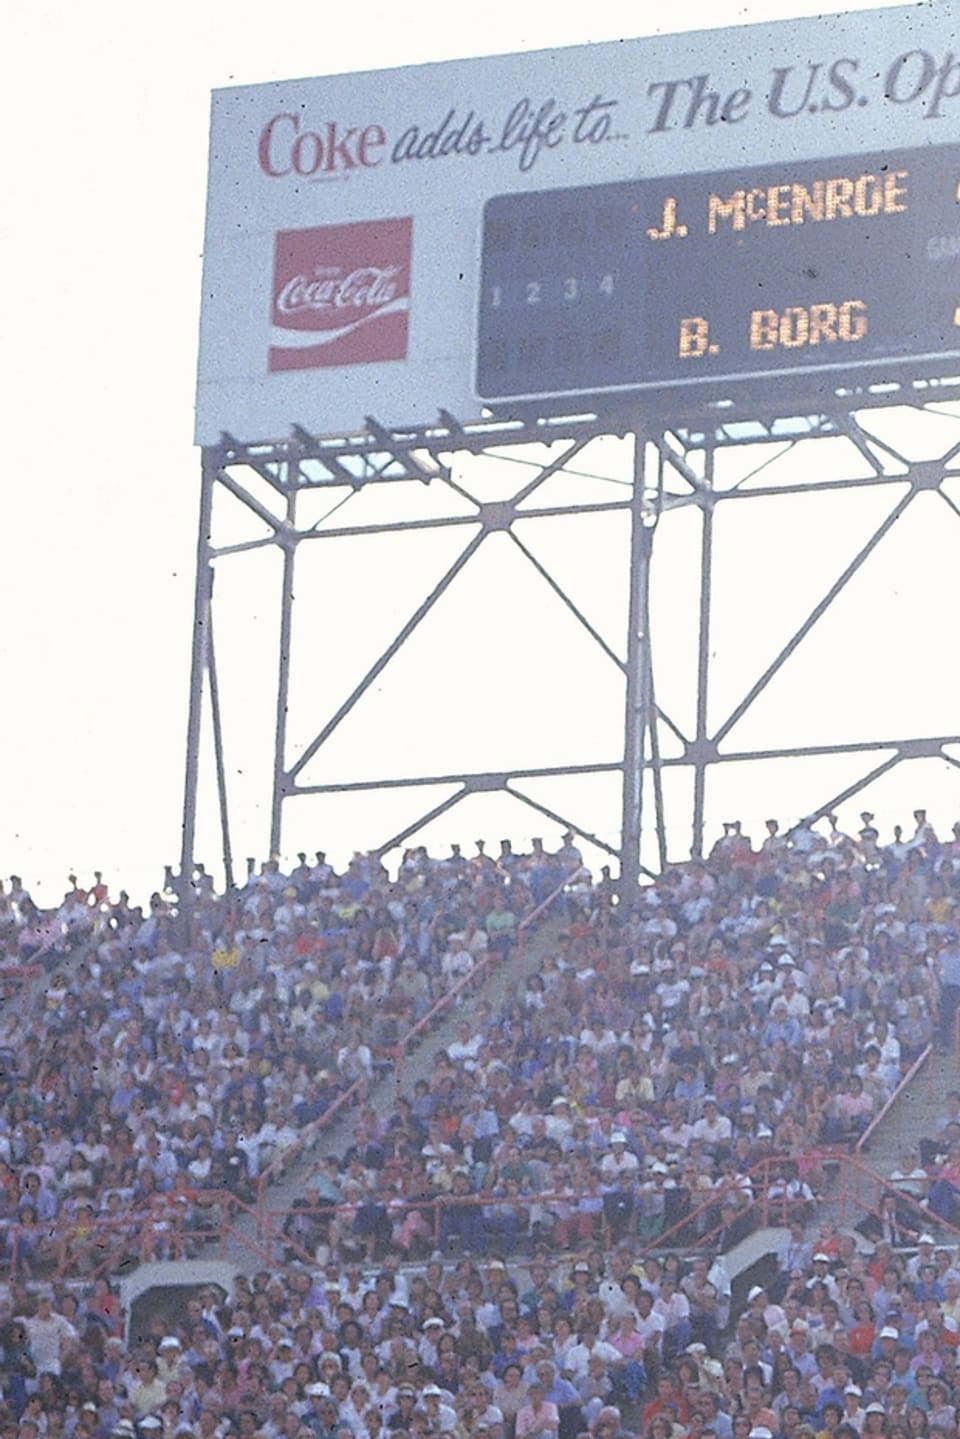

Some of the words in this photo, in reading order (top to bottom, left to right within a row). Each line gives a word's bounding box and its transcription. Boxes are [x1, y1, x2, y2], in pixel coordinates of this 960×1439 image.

[258, 112, 387, 178] Coke
[391, 109, 491, 164] adds
[488, 97, 567, 172] life
[647, 73, 753, 134] The
[767, 57, 868, 119] U.S.
[646, 197, 689, 241] J.
[276, 264, 399, 315] Coca-Cola
[526, 281, 542, 304] 2
[563, 276, 578, 301] 3
[600, 272, 615, 296] 4
[679, 316, 721, 359] B.
[749, 299, 868, 350] BORG
